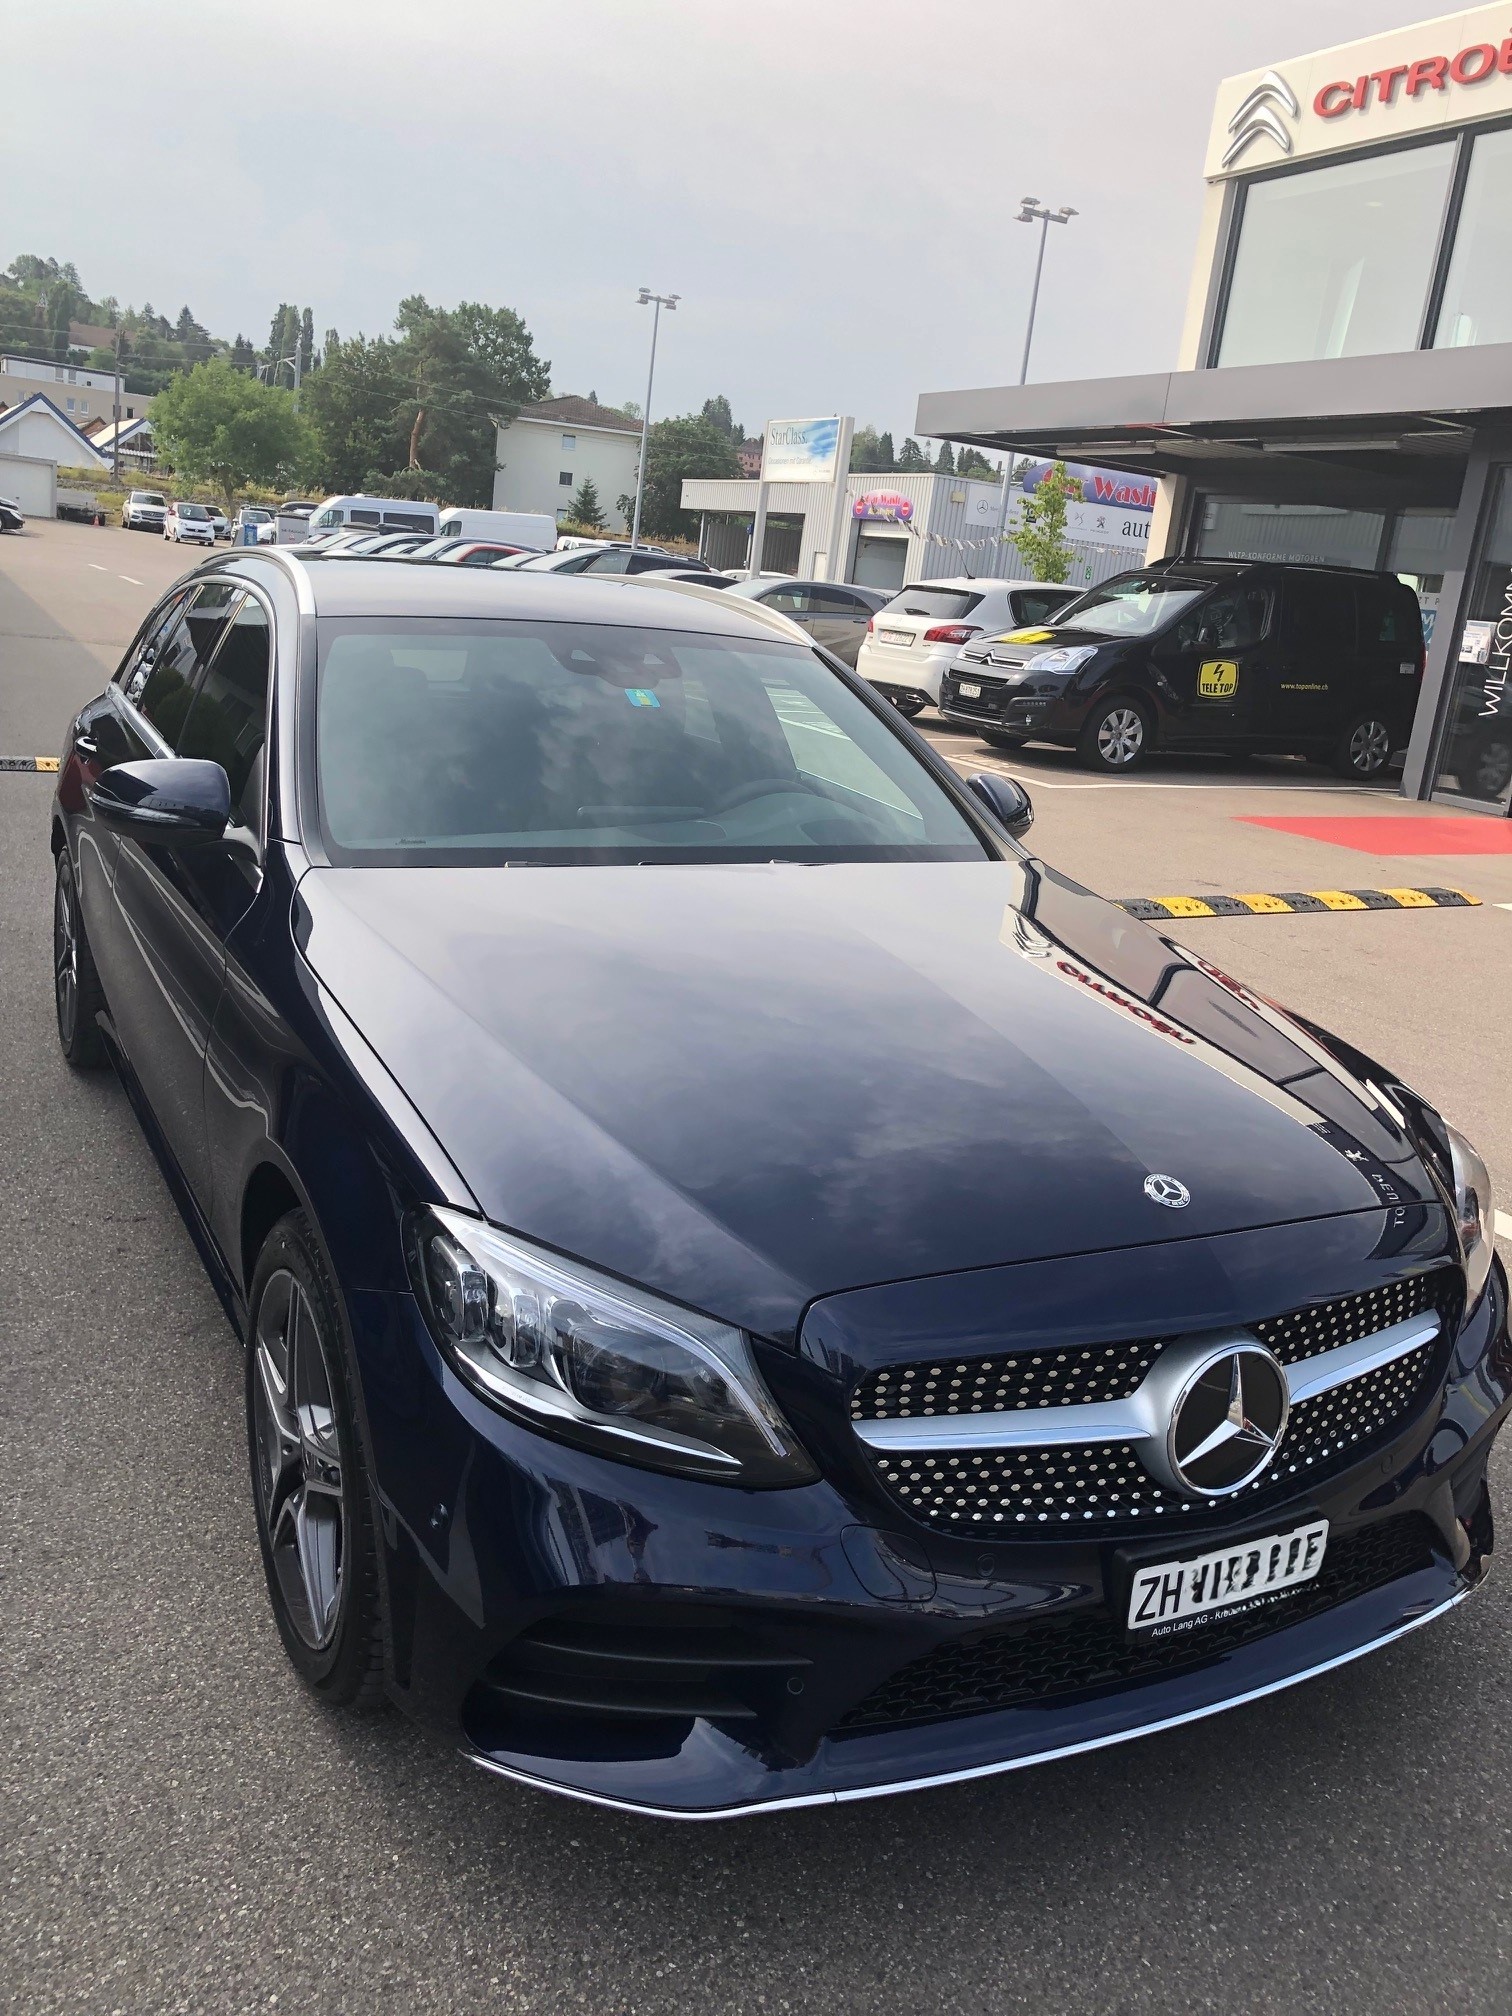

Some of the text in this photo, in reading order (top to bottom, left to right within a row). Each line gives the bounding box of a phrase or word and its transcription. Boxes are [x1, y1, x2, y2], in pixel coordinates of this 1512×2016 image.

[1094, 476, 1156, 507] Wash
[1288, 554, 1325, 563] MOTOREN
[1202, 683, 1234, 693] TELE TOP
[1151, 1625, 1171, 1638] Auto
[1173, 1619, 1194, 1632] Lang
[1194, 1614, 1208, 1626] AG
